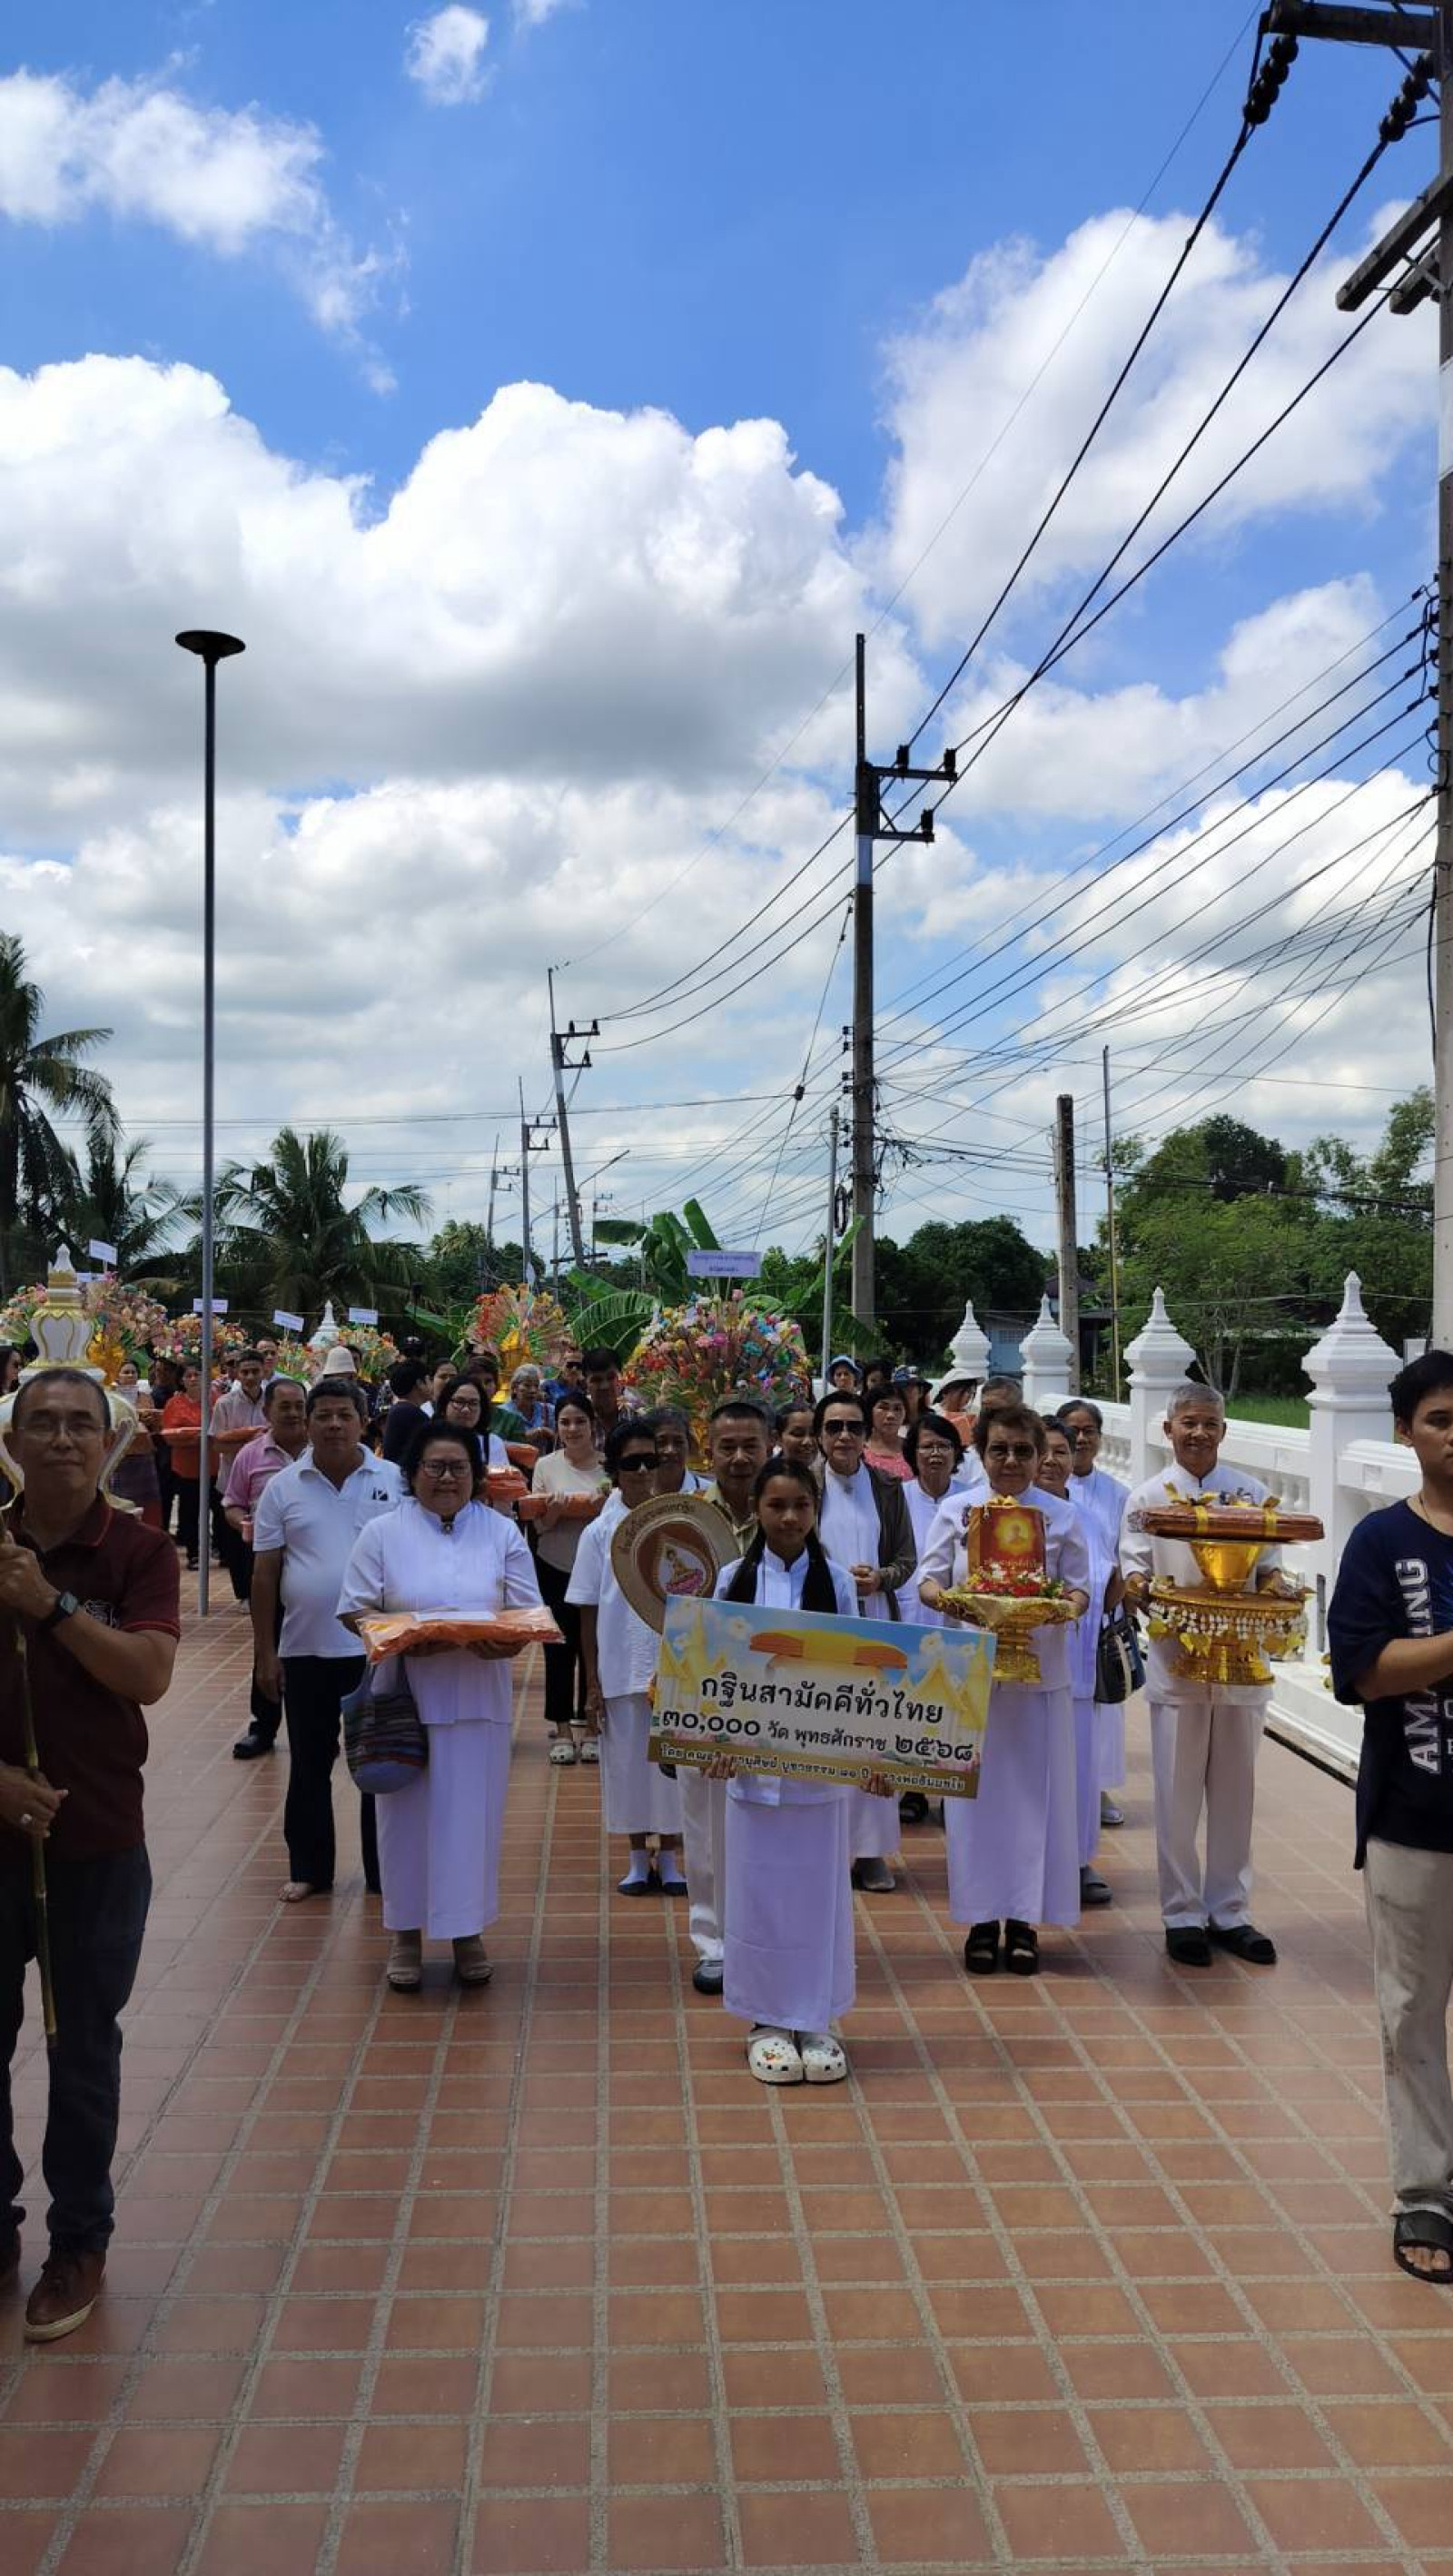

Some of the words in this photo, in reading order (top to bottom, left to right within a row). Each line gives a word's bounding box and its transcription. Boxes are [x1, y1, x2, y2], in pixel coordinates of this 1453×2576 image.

[1395, 1558, 1440, 1774] AMING
[701, 1671, 944, 1723] กฐินสามัคคีทั่วไทย
[663, 1710, 760, 1736] ๓๐,๐๐๐
[767, 1719, 789, 1740] วัด
[796, 1727, 886, 1752] พุทธศักราช
[895, 1734, 974, 1761] ๒๕๖๘
